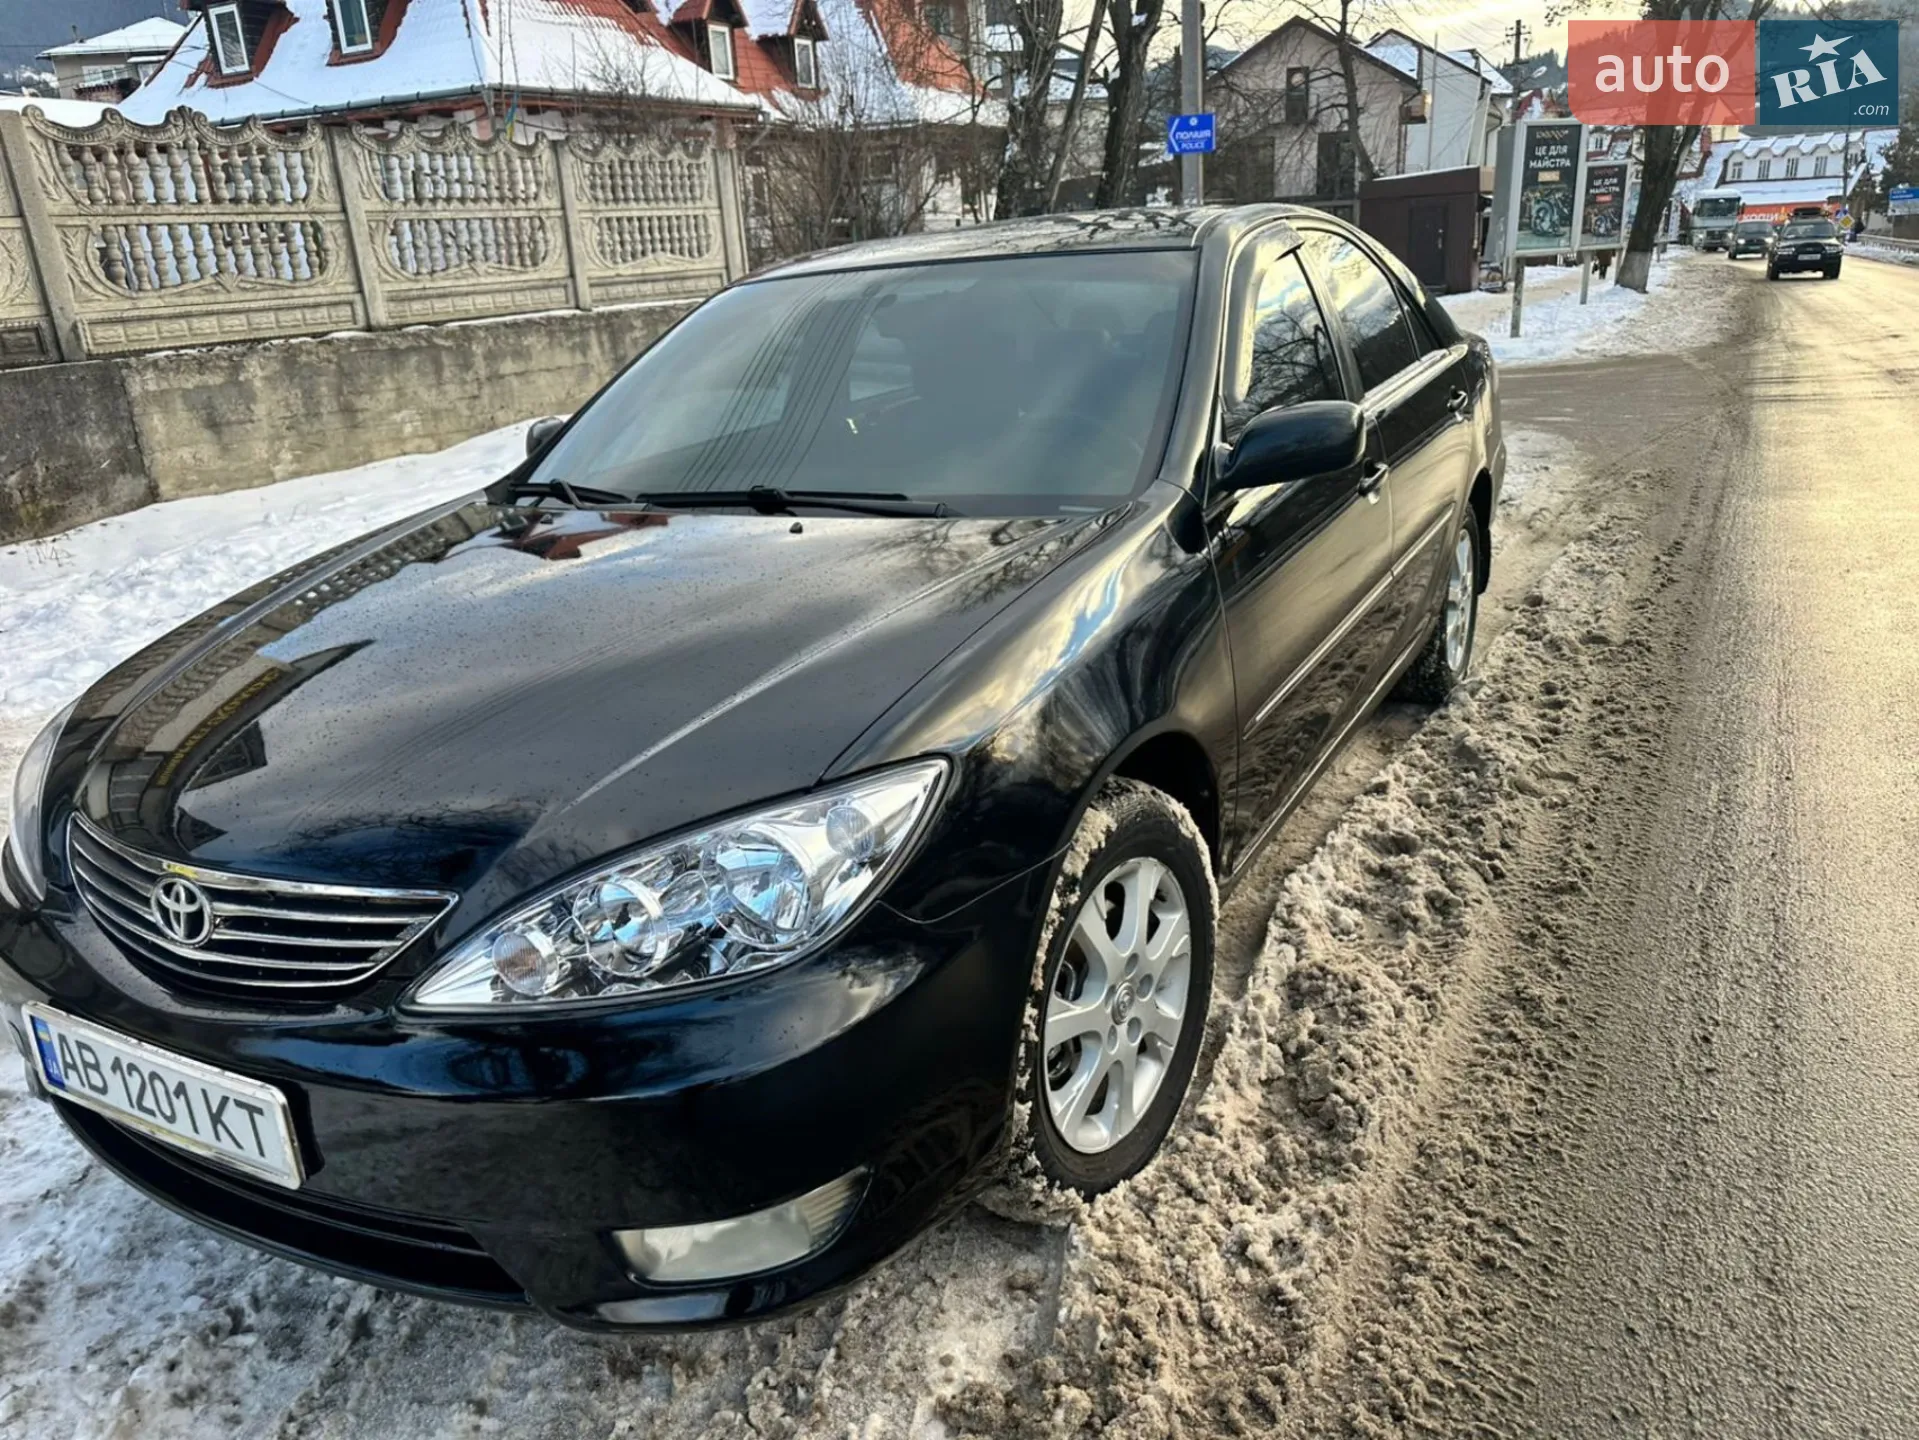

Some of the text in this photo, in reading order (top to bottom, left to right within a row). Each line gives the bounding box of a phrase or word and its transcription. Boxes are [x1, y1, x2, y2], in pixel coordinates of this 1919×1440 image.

[1535, 145, 1568, 156] ЦЕ ДЛЯ
[1529, 156, 1571, 168] МАЙСТРА
[111, 1056, 199, 1134] 1201
[201, 1087, 265, 1158] KT
